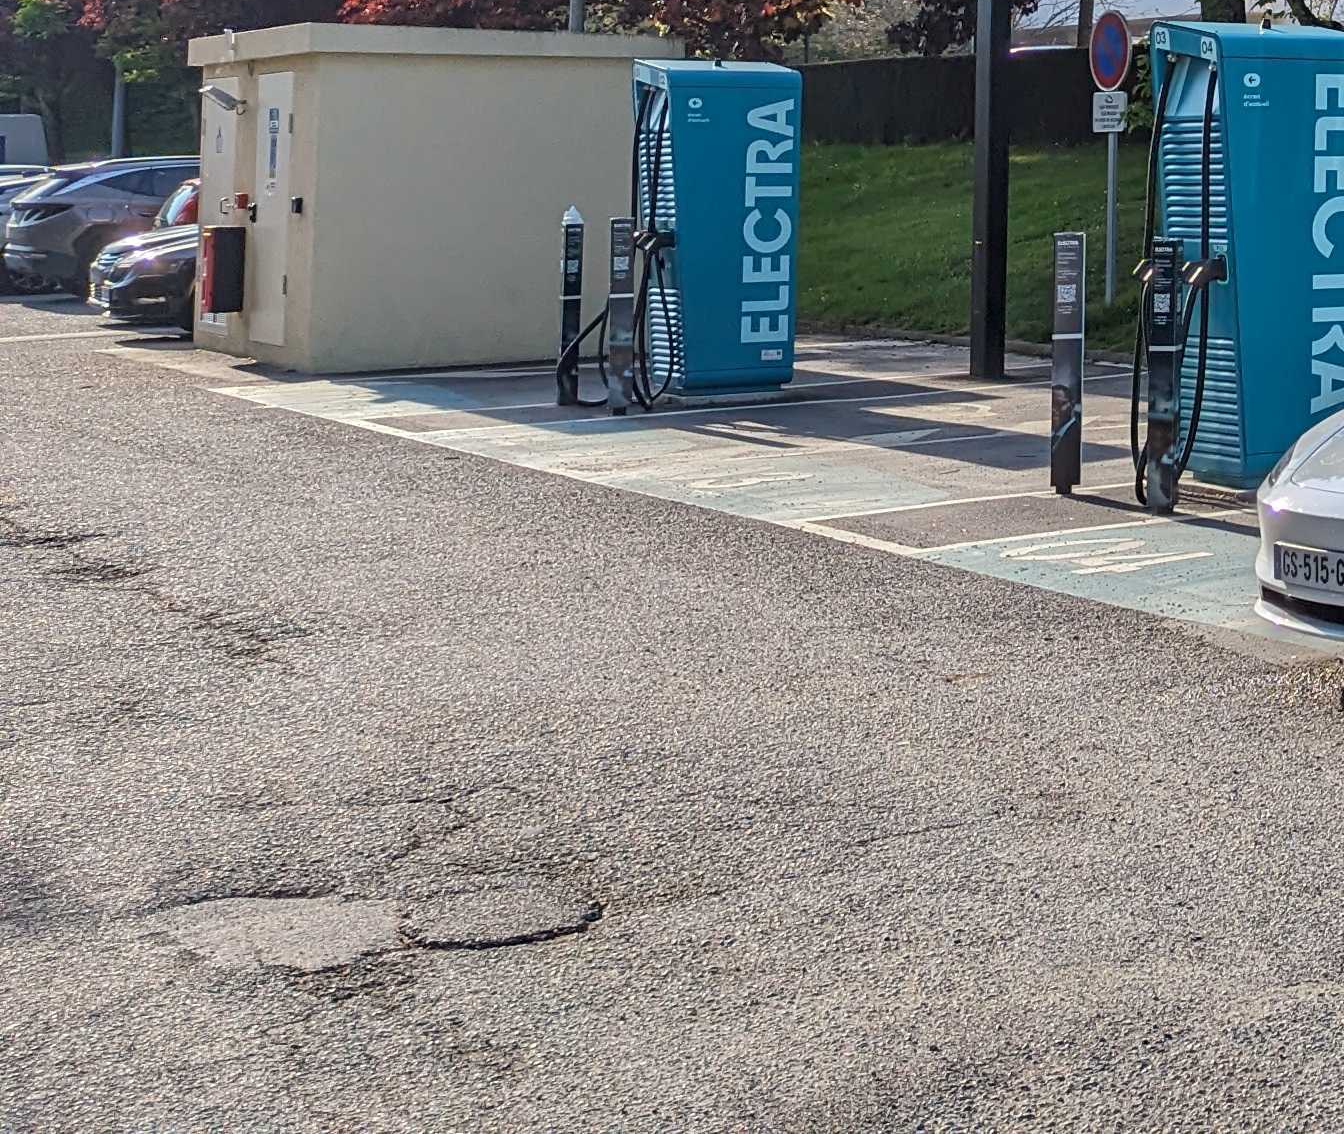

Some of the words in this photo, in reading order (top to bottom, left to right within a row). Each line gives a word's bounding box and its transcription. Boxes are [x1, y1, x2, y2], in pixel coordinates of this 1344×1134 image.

[1155, 31, 1167, 44] 03
[1201, 41, 1213, 54] 04
[741, 99, 795, 343] ELECTRA
